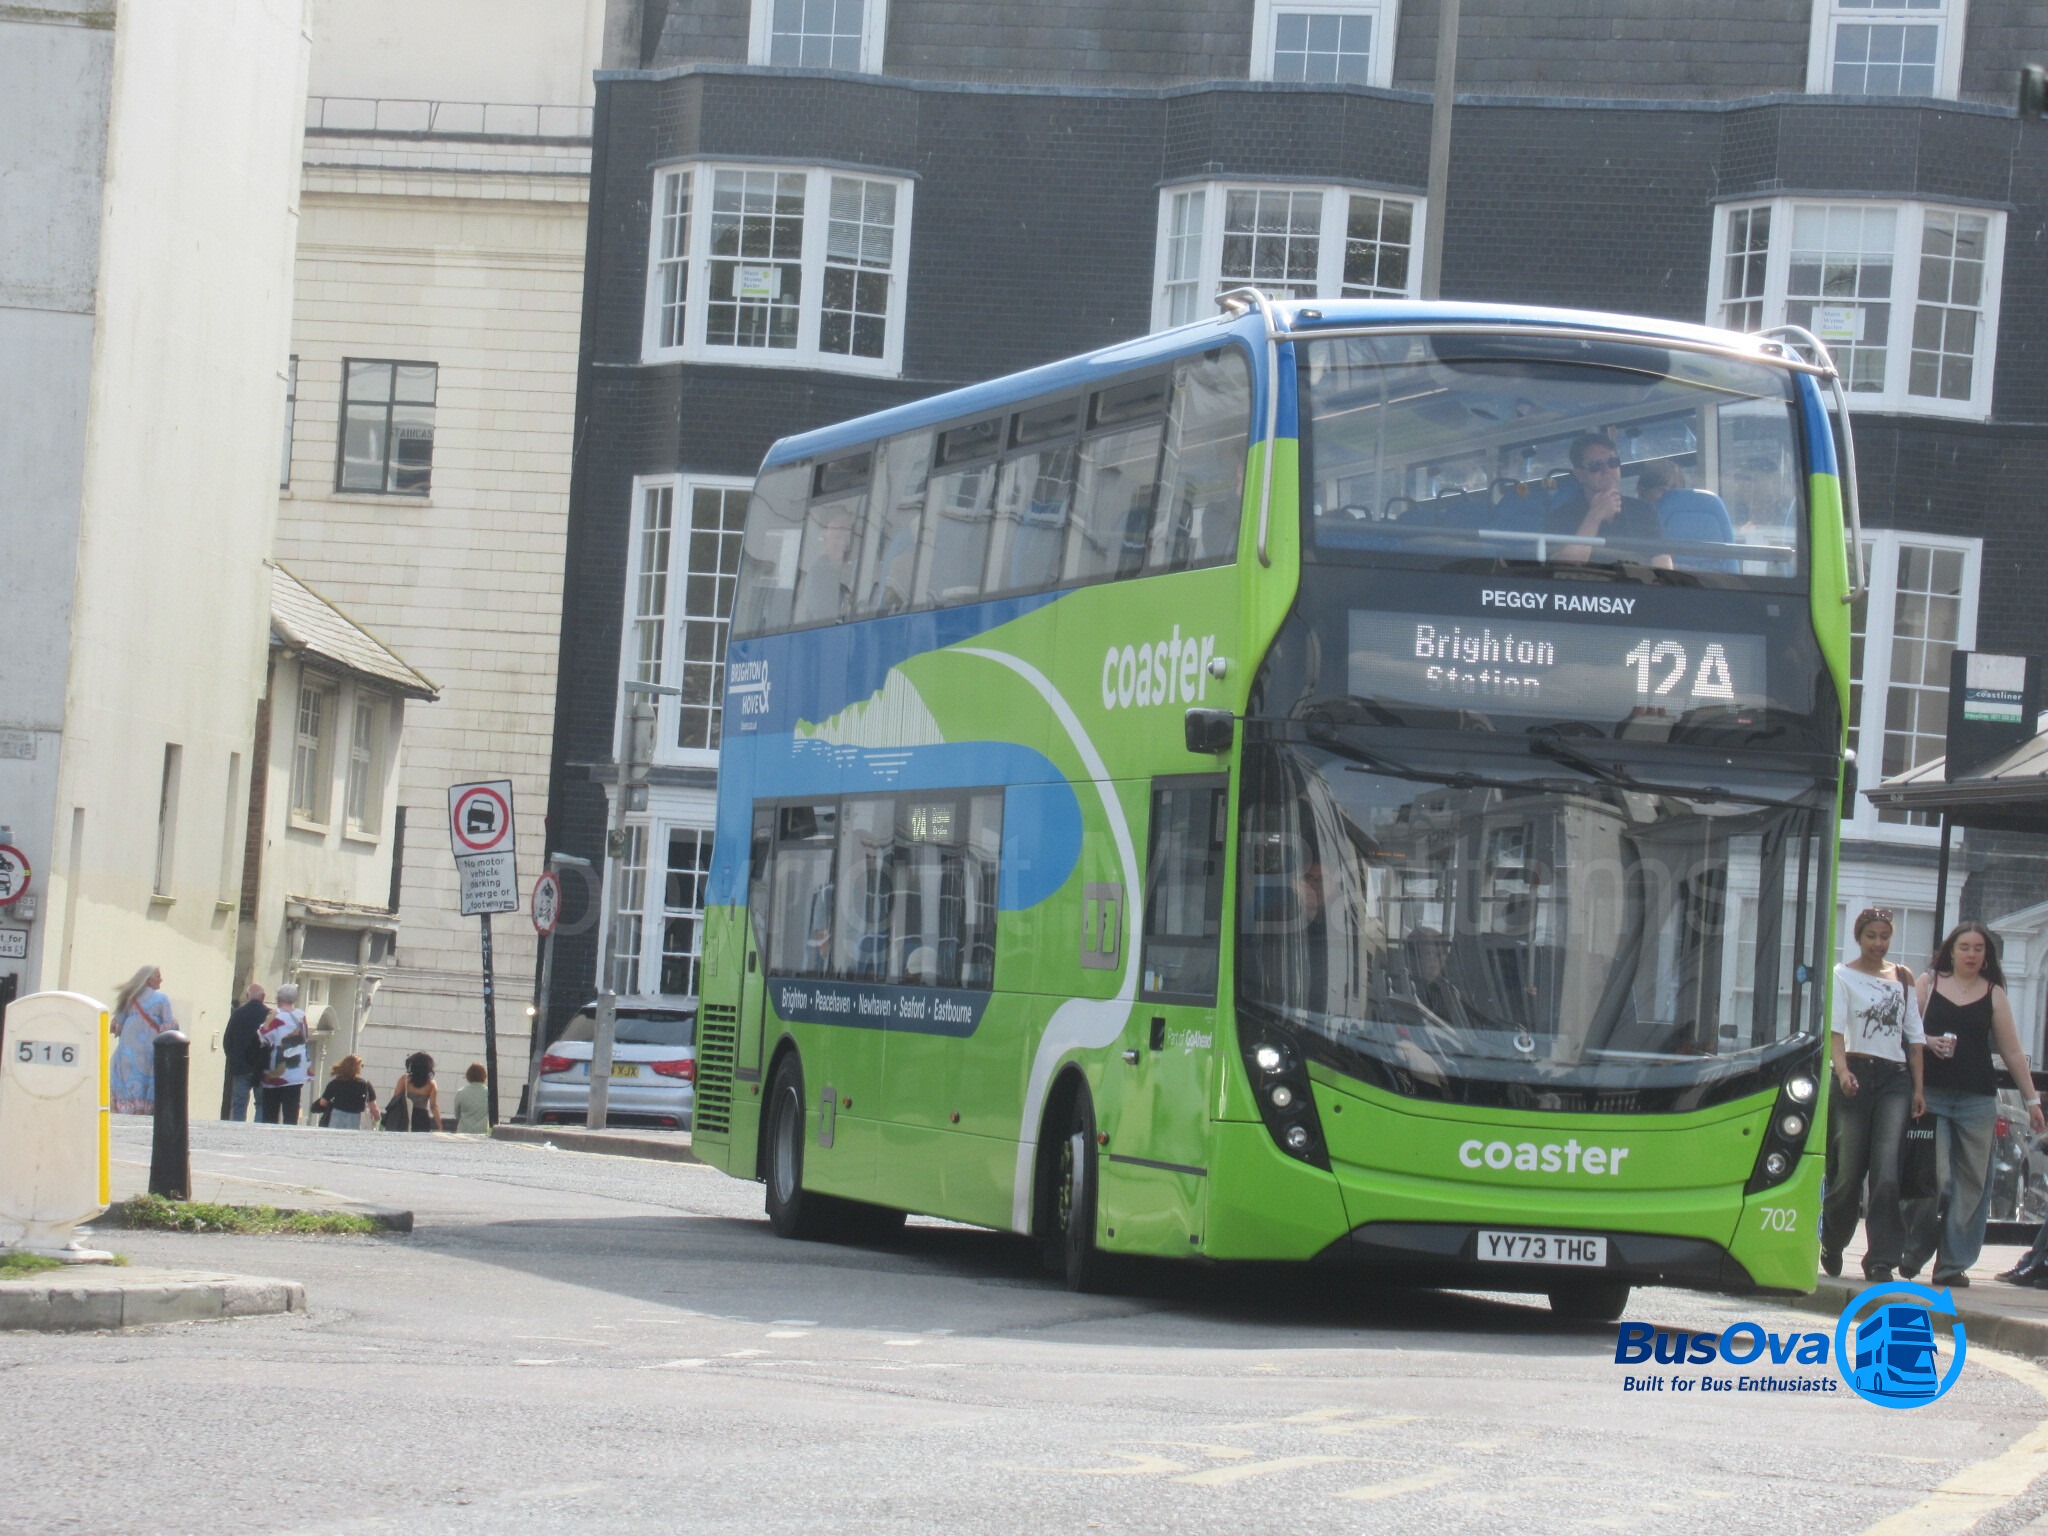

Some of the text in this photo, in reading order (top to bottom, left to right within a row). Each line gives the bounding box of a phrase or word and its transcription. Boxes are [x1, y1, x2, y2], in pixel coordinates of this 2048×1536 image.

[1481, 589, 1636, 615] PEGGY RAMSAY
[731, 662, 761, 682] BRIGHTON
[1102, 624, 1214, 711] coaster
[1415, 624, 1735, 699] Brighton 12A
[1426, 665, 1541, 698] Station
[742, 695, 759, 714] HOVE
[1976, 690, 2022, 700] coastliner
[464, 858, 504, 868] No motor
[471, 868, 499, 878] vehicle
[471, 880, 500, 889] parking
[475, 890, 497, 899] verge
[9, 935, 22, 943] for
[782, 986, 971, 1023] Brighton Peacehaven Newhaven Seaford Eastbourne
[1459, 1139, 1629, 1175] coaster
[1760, 1206, 1797, 1232] 702
[1488, 1234, 1597, 1261] YY73 THG
